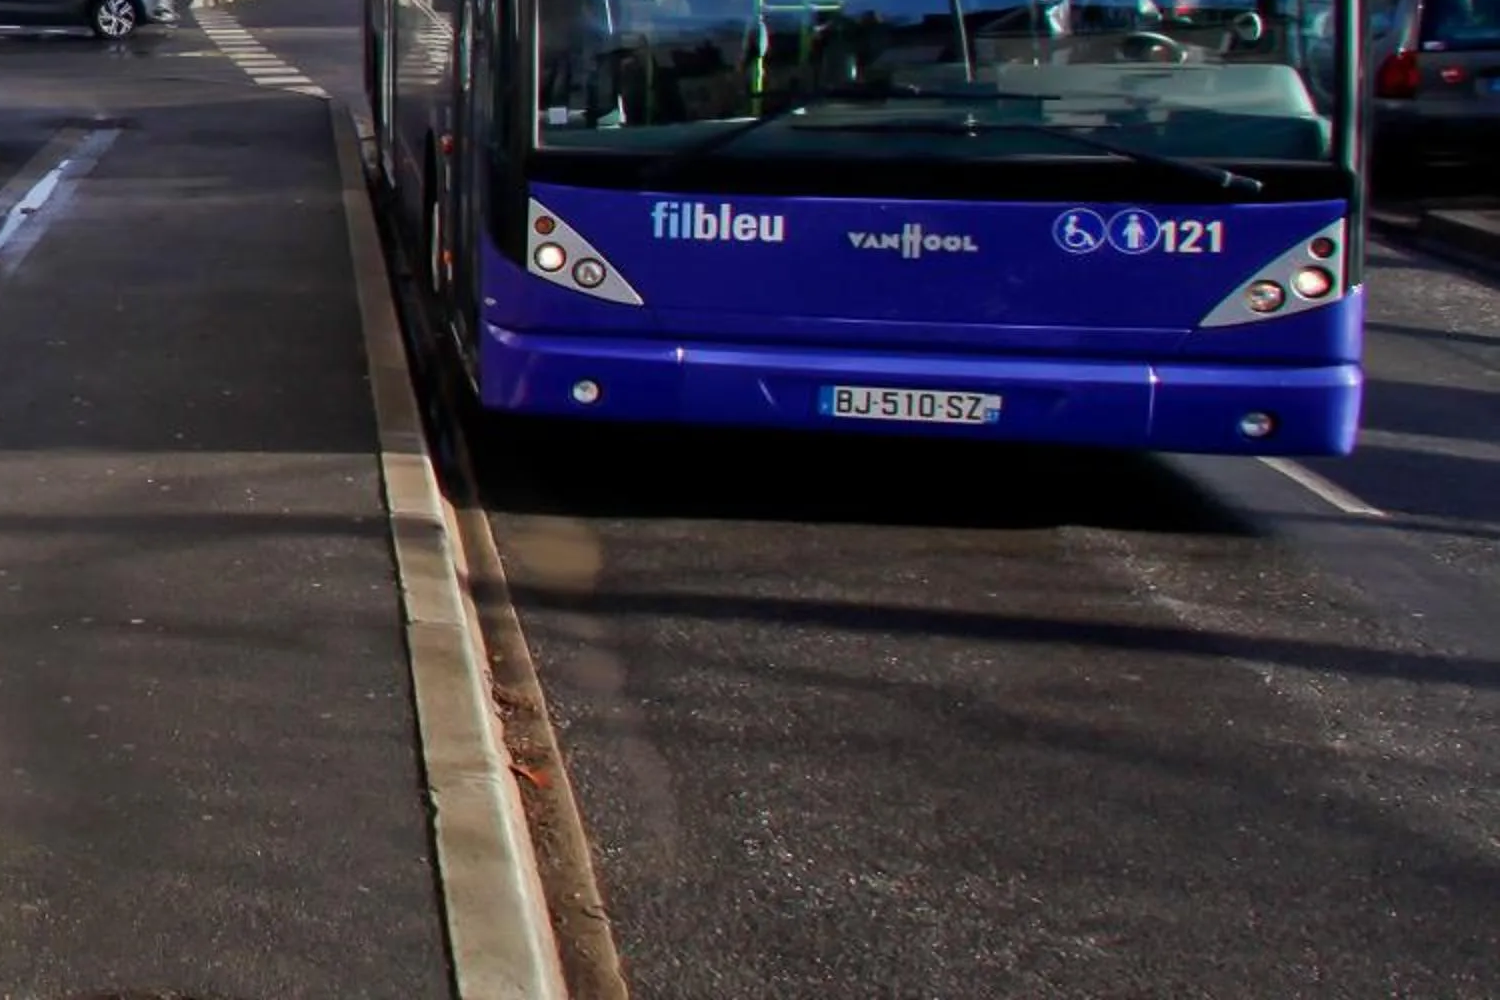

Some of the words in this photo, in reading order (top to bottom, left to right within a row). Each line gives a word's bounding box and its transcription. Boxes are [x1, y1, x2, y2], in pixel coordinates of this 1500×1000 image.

[651, 201, 785, 242] filbleu
[1161, 219, 1223, 253] 121
[836, 389, 983, 420] BJ-510-SZ
